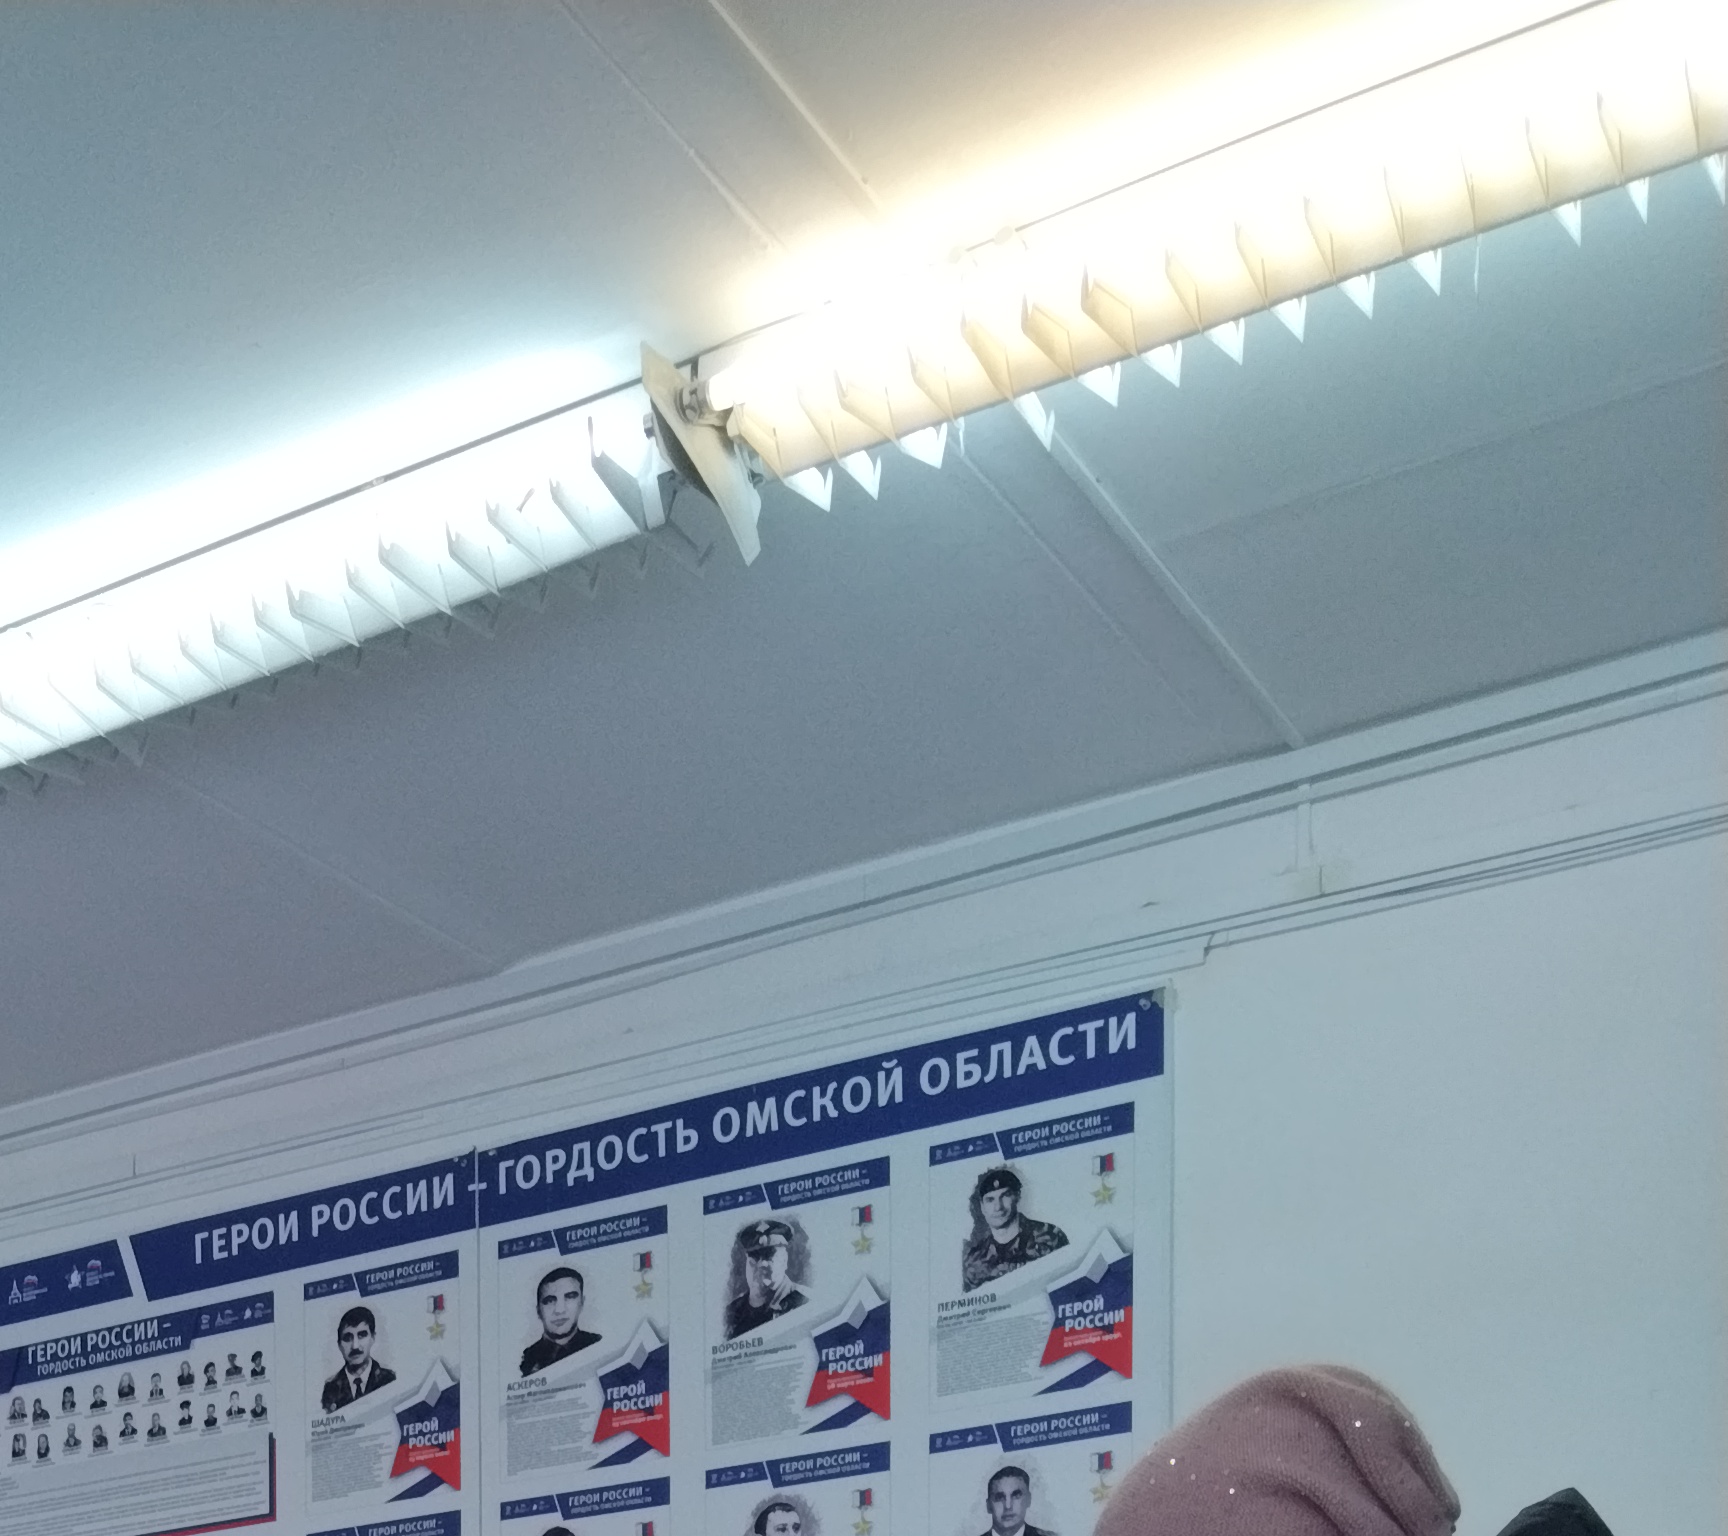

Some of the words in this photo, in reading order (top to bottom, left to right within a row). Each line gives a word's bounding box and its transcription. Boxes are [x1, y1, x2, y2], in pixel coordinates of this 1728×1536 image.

[195, 1210, 299, 1264] ГЕРОИ
[312, 1172, 454, 1237] РОССИИ
[497, 1119, 699, 1194] ГОРДОСТЬ
[712, 1061, 904, 1146] ОМСКОЙ
[920, 1010, 1138, 1096] ОБЛАСТИ
[1012, 1125, 1049, 1144] ГЕРОИ
[1053, 1114, 1100, 1135] РОССИИ
[778, 1178, 812, 1195] ГЕРОИ
[815, 1167, 859, 1187] РОССИИ
[566, 1225, 597, 1241] ГЕРОИ
[599, 1215, 639, 1234] РОССИИ
[937, 1292, 996, 1313] ПЕРМИНОВ
[1058, 1293, 1104, 1319] ГЕРОЙ
[1065, 1308, 1124, 1333] РОССИИ
[28, 1336, 81, 1364] ГЕРОИ
[87, 1319, 158, 1352] РОССИИ
[822, 1338, 864, 1362] ГЕРОЙ
[38, 1357, 86, 1376] ГОРДОСТЬ
[89, 1345, 132, 1365] ОМСКОЙ
[135, 1336, 181, 1356] ОБЛАСТИ
[828, 1352, 883, 1376] РОССИИ
[506, 1376, 547, 1392] АСКЕРОВ
[607, 1379, 645, 1400] ГЕРОЙ
[613, 1392, 662, 1413] РОССИИ
[311, 1414, 345, 1429] ШАДУРА
[403, 1416, 438, 1436] ГЕРОЙ
[1010, 1420, 1047, 1437] ГЕРОИ
[1051, 1412, 1098, 1430] РОССИИ
[409, 1429, 454, 1449] РОССИИ
[779, 1458, 813, 1474] ГЕРОИ
[816, 1450, 860, 1468] РОССИИ
[568, 1492, 599, 1507] ГЕРОИ
[602, 1485, 642, 1501] РОССИИ
